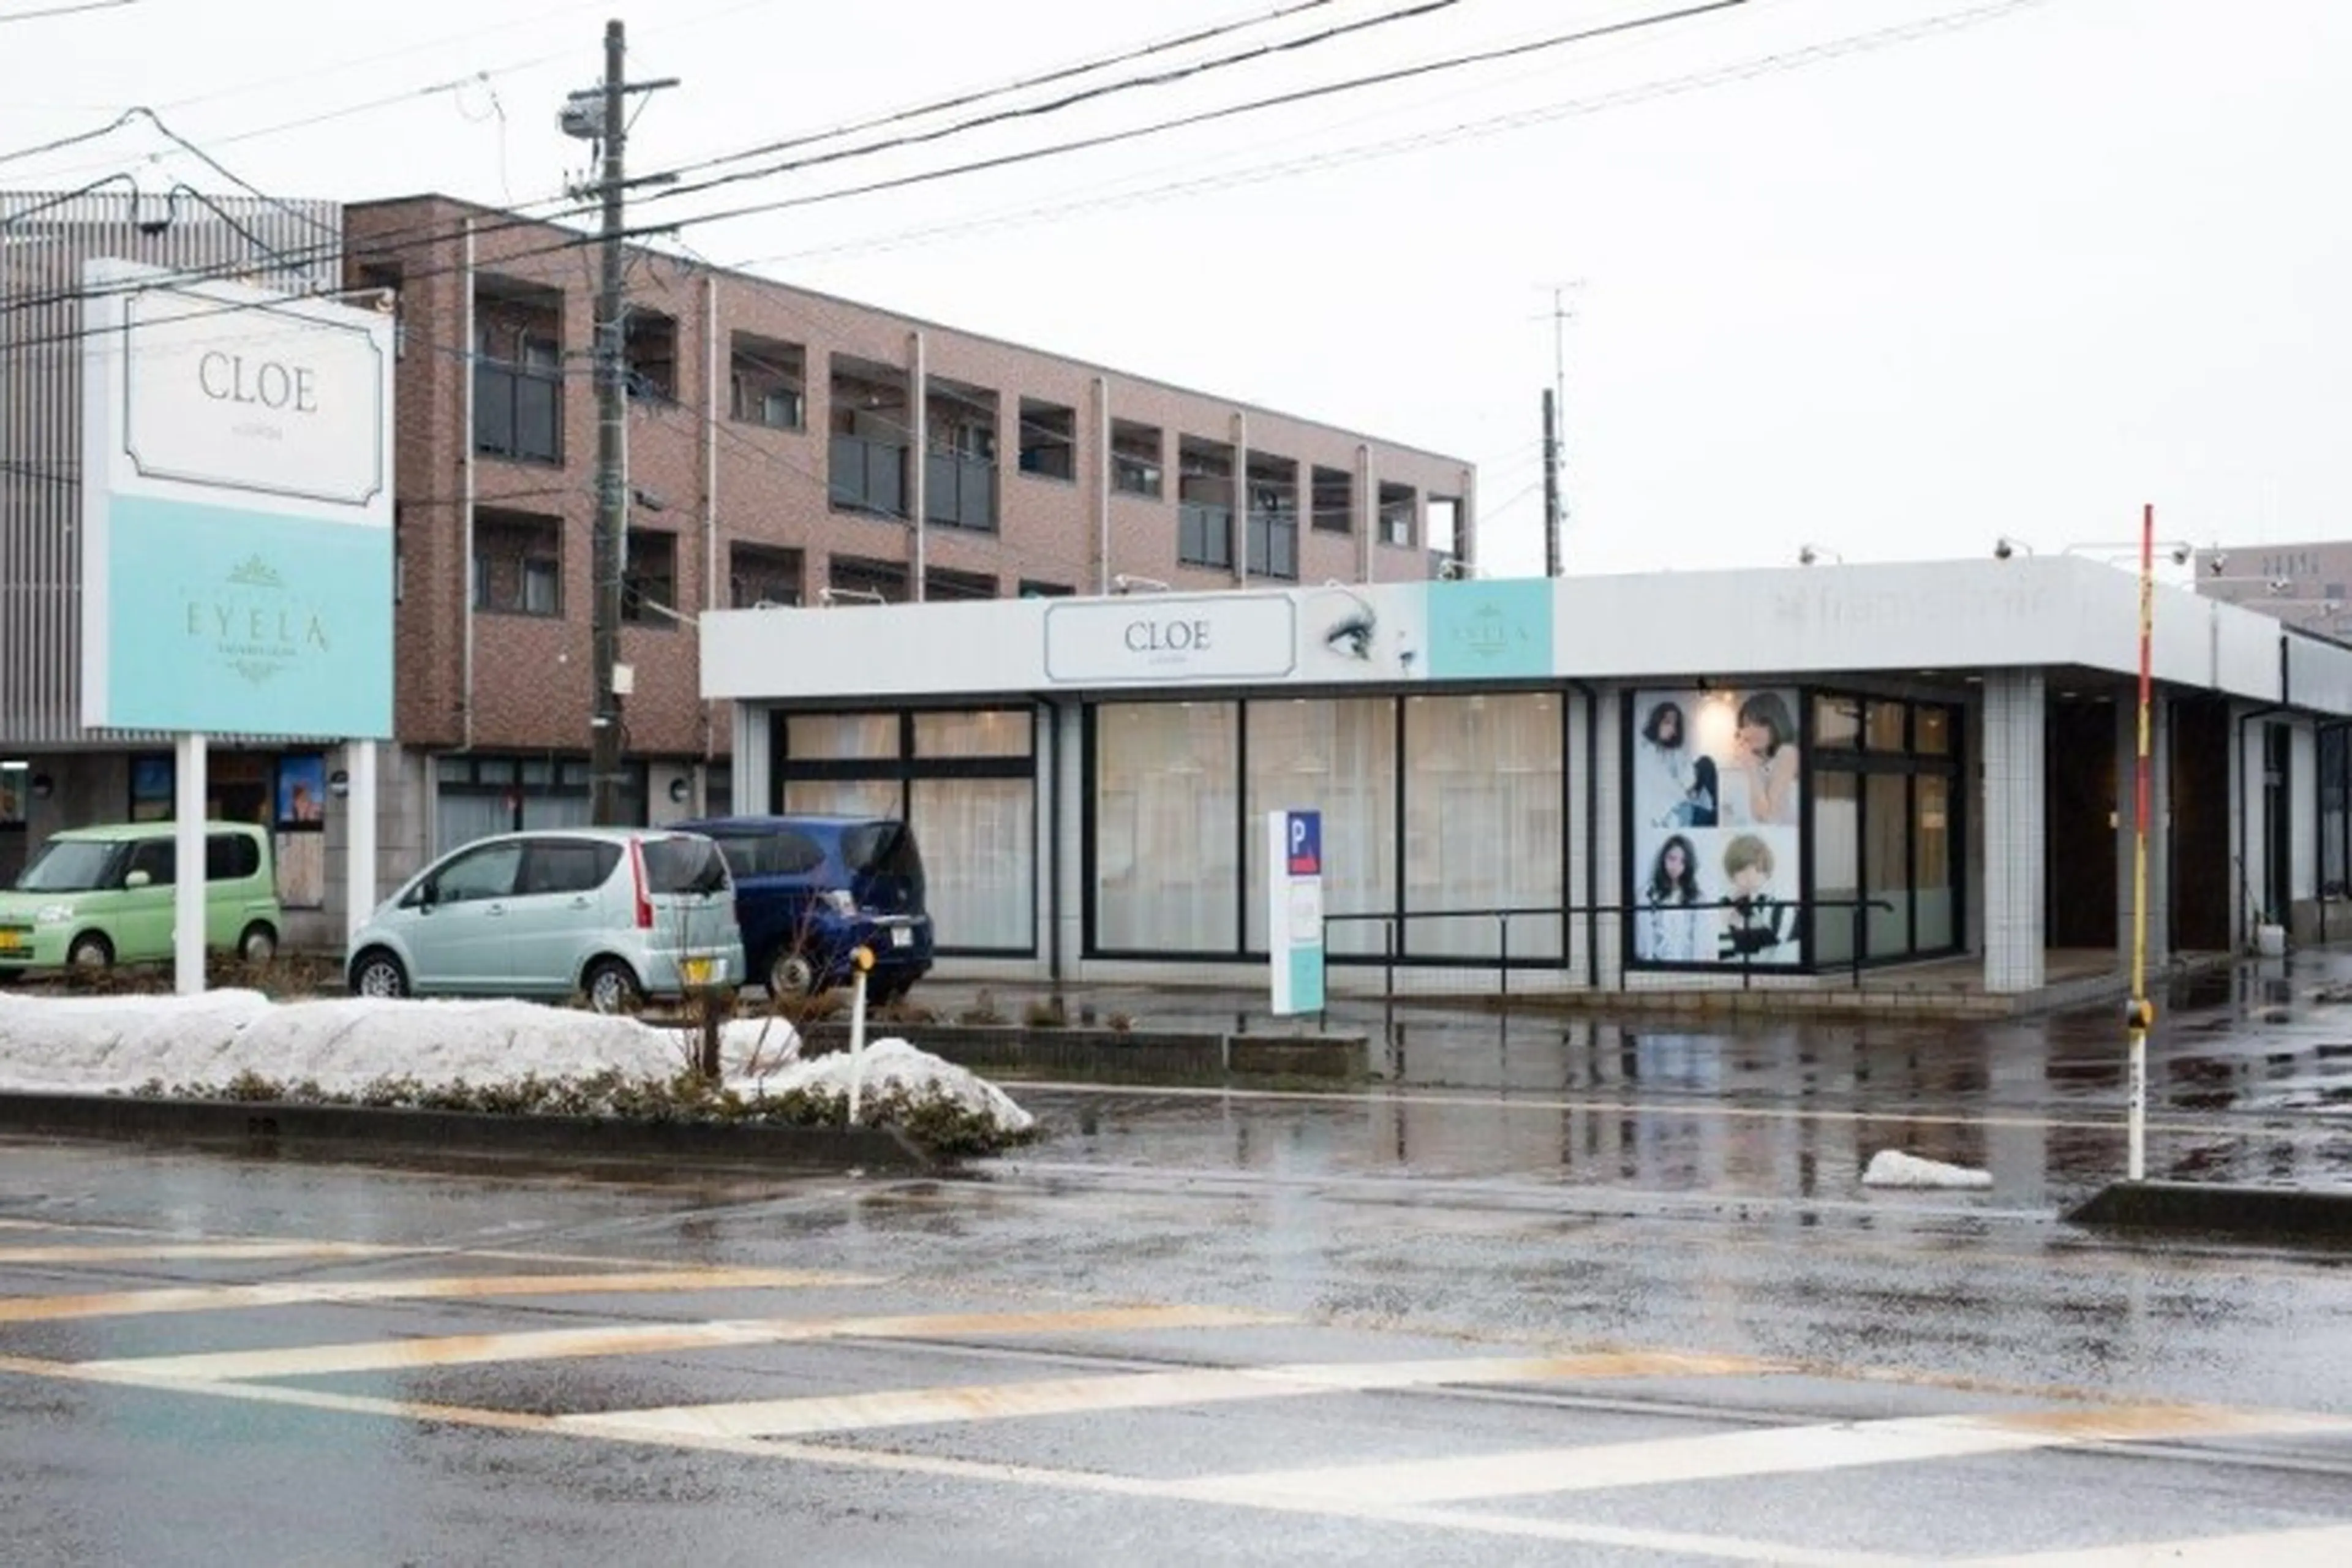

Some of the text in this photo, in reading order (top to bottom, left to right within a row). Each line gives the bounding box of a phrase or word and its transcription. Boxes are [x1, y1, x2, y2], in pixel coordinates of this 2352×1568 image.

[200, 350, 317, 413] CLOE
[187, 601, 328, 651] EYELA
[1125, 619, 1212, 652] CLOE
[1291, 819, 1305, 854] P
